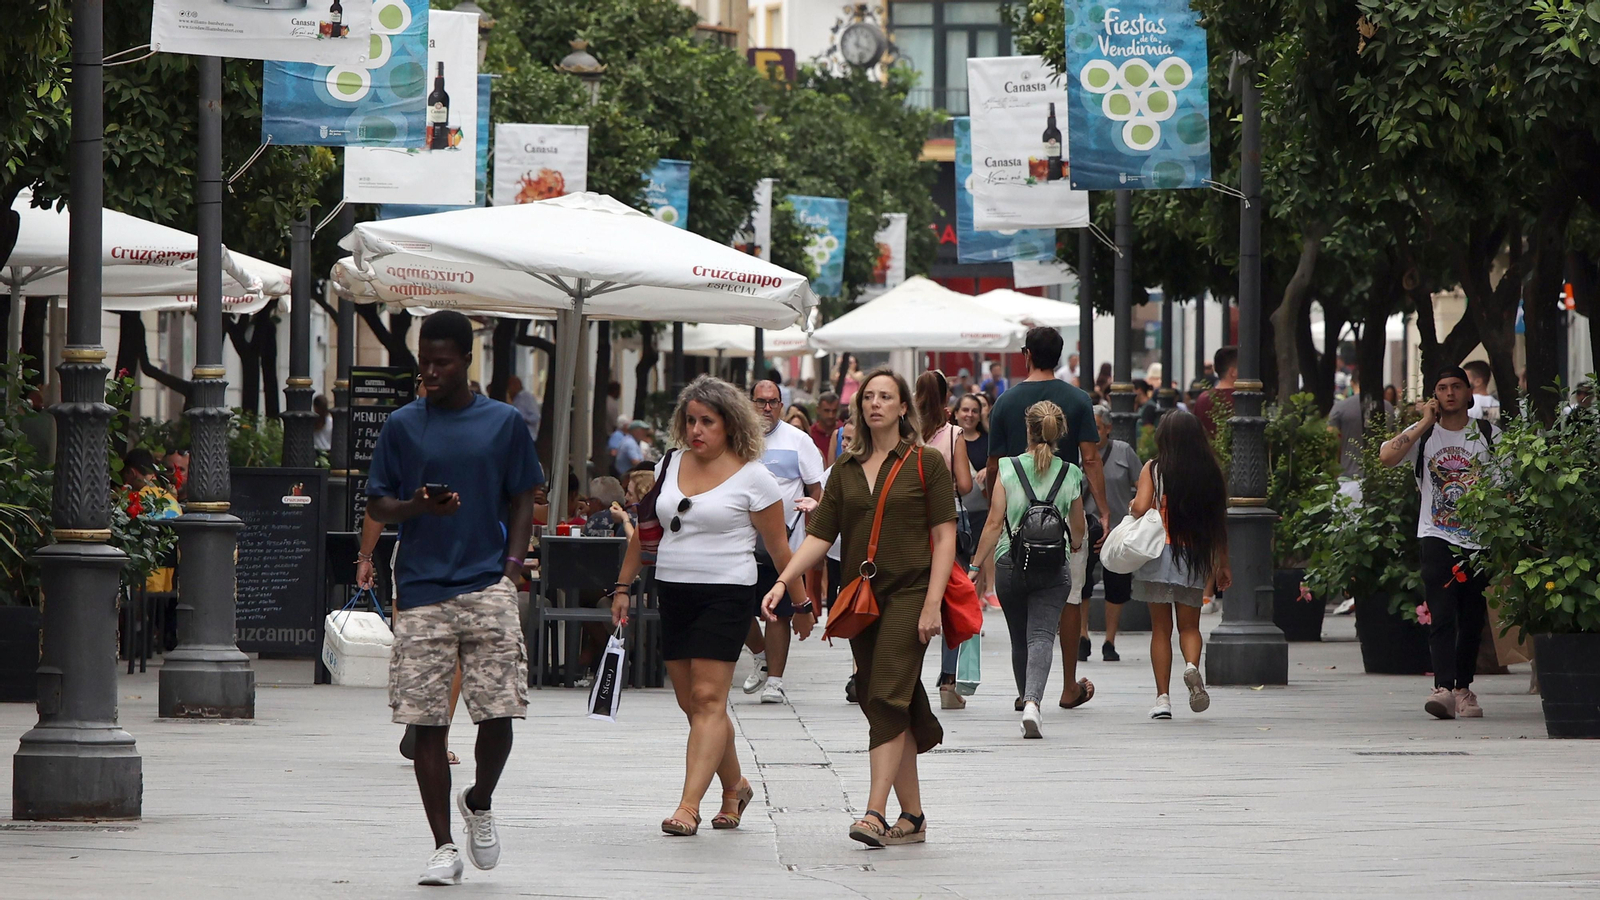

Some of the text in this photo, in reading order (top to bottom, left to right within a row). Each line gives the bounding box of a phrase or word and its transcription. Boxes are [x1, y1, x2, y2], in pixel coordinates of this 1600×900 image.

[291, 18, 316, 26] Canasta
[1101, 8, 1167, 36] Fiestas
[1140, 34, 1158, 43] de la
[1098, 34, 1174, 57] Vendimia
[1004, 81, 1047, 93] Canasta
[524, 143, 558, 154] Canasta
[984, 157, 1022, 168] Canasta
[692, 266, 782, 288] Cruzcampo
[706, 282, 758, 296] ESPECIAL
[353, 412, 376, 422] MENU
